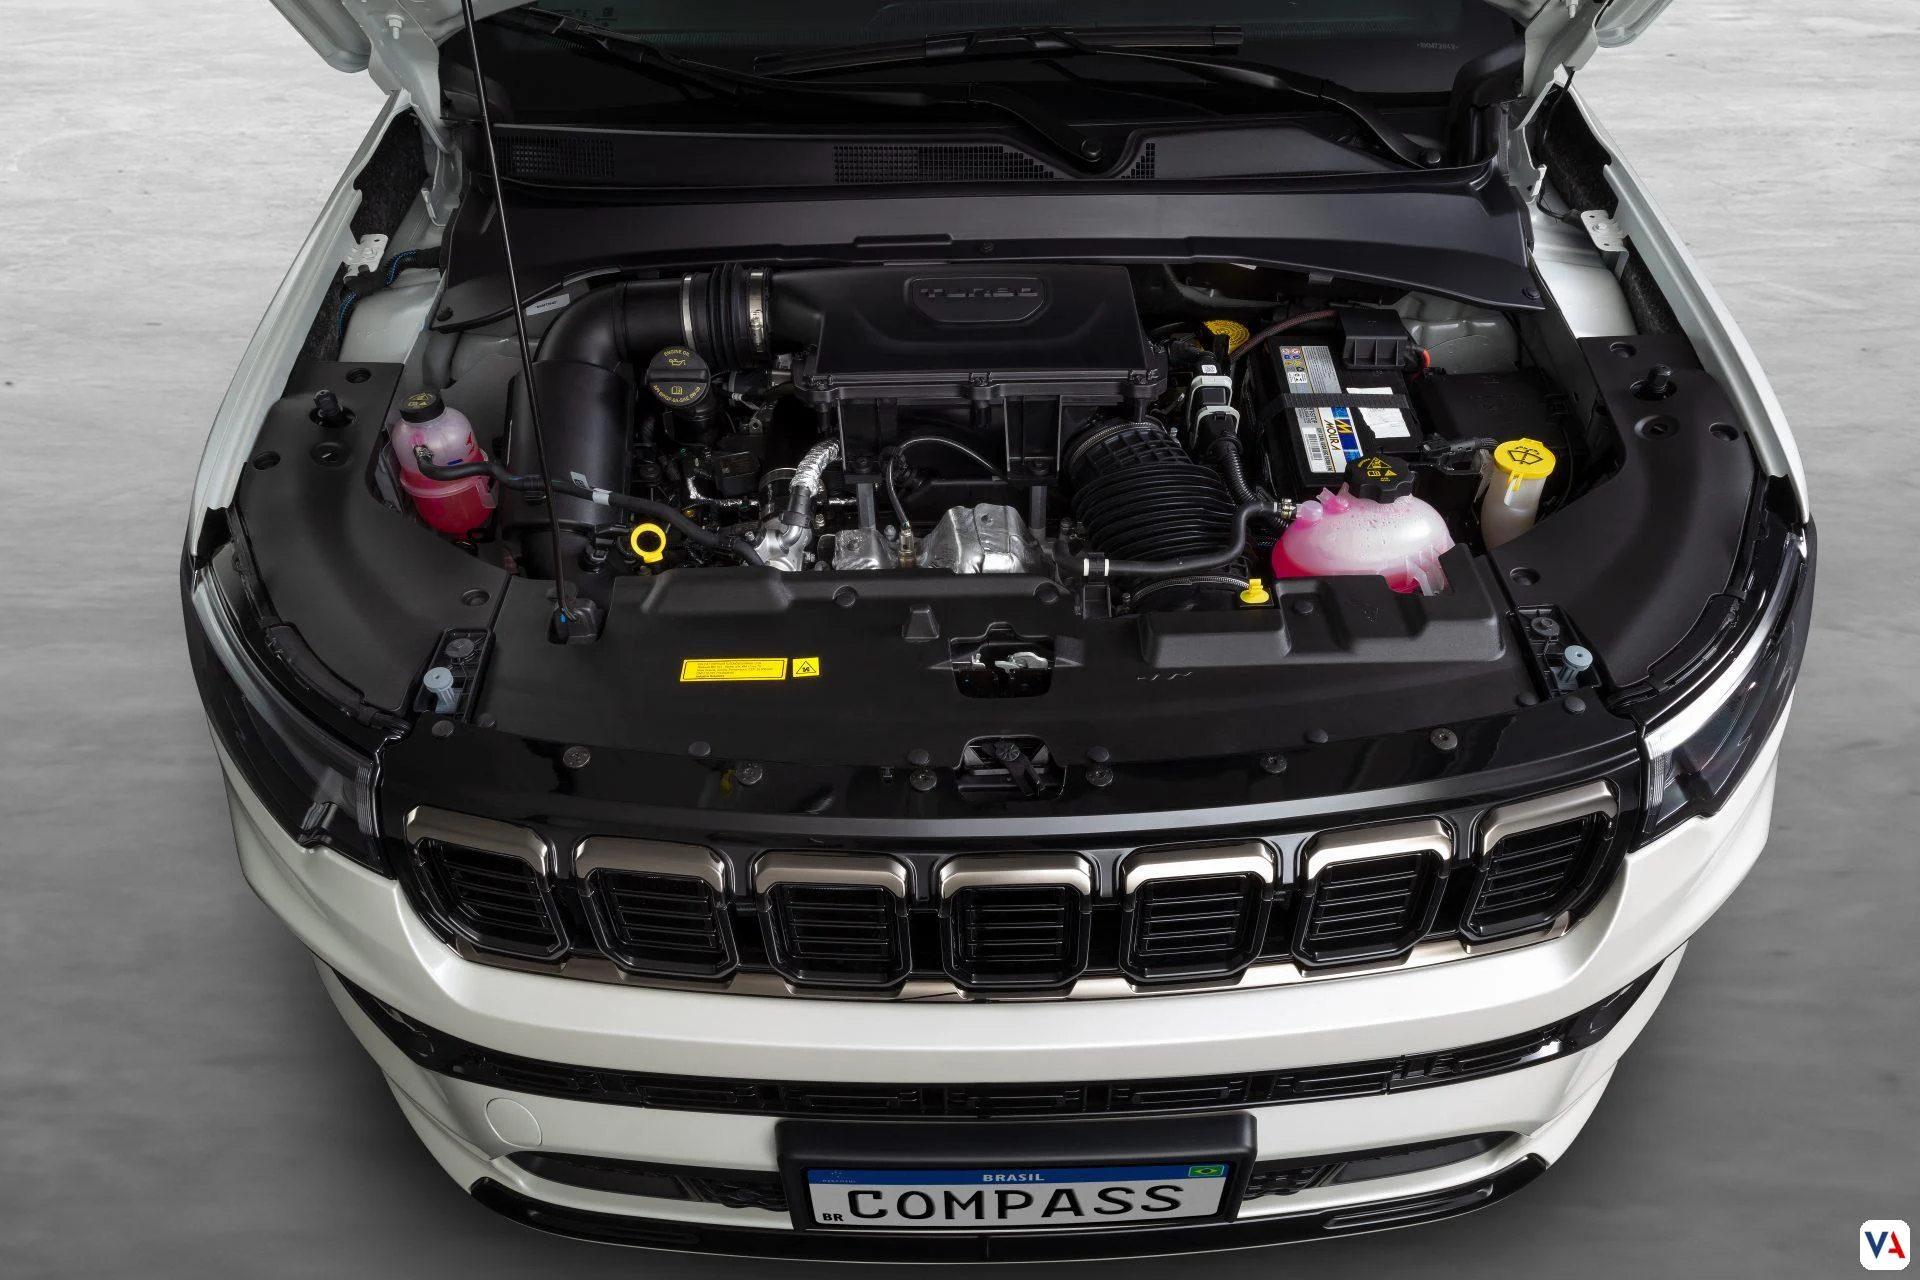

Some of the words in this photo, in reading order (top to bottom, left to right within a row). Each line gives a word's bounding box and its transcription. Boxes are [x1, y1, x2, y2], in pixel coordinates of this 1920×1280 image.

[663, 349, 682, 357] ENGINE
[682, 349, 690, 357] OIL
[1324, 419, 1342, 451] MOURA
[982, 1173, 1045, 1182] BRASIL
[847, 1185, 1184, 1220] COMPASS
[822, 1212, 844, 1222] BR
